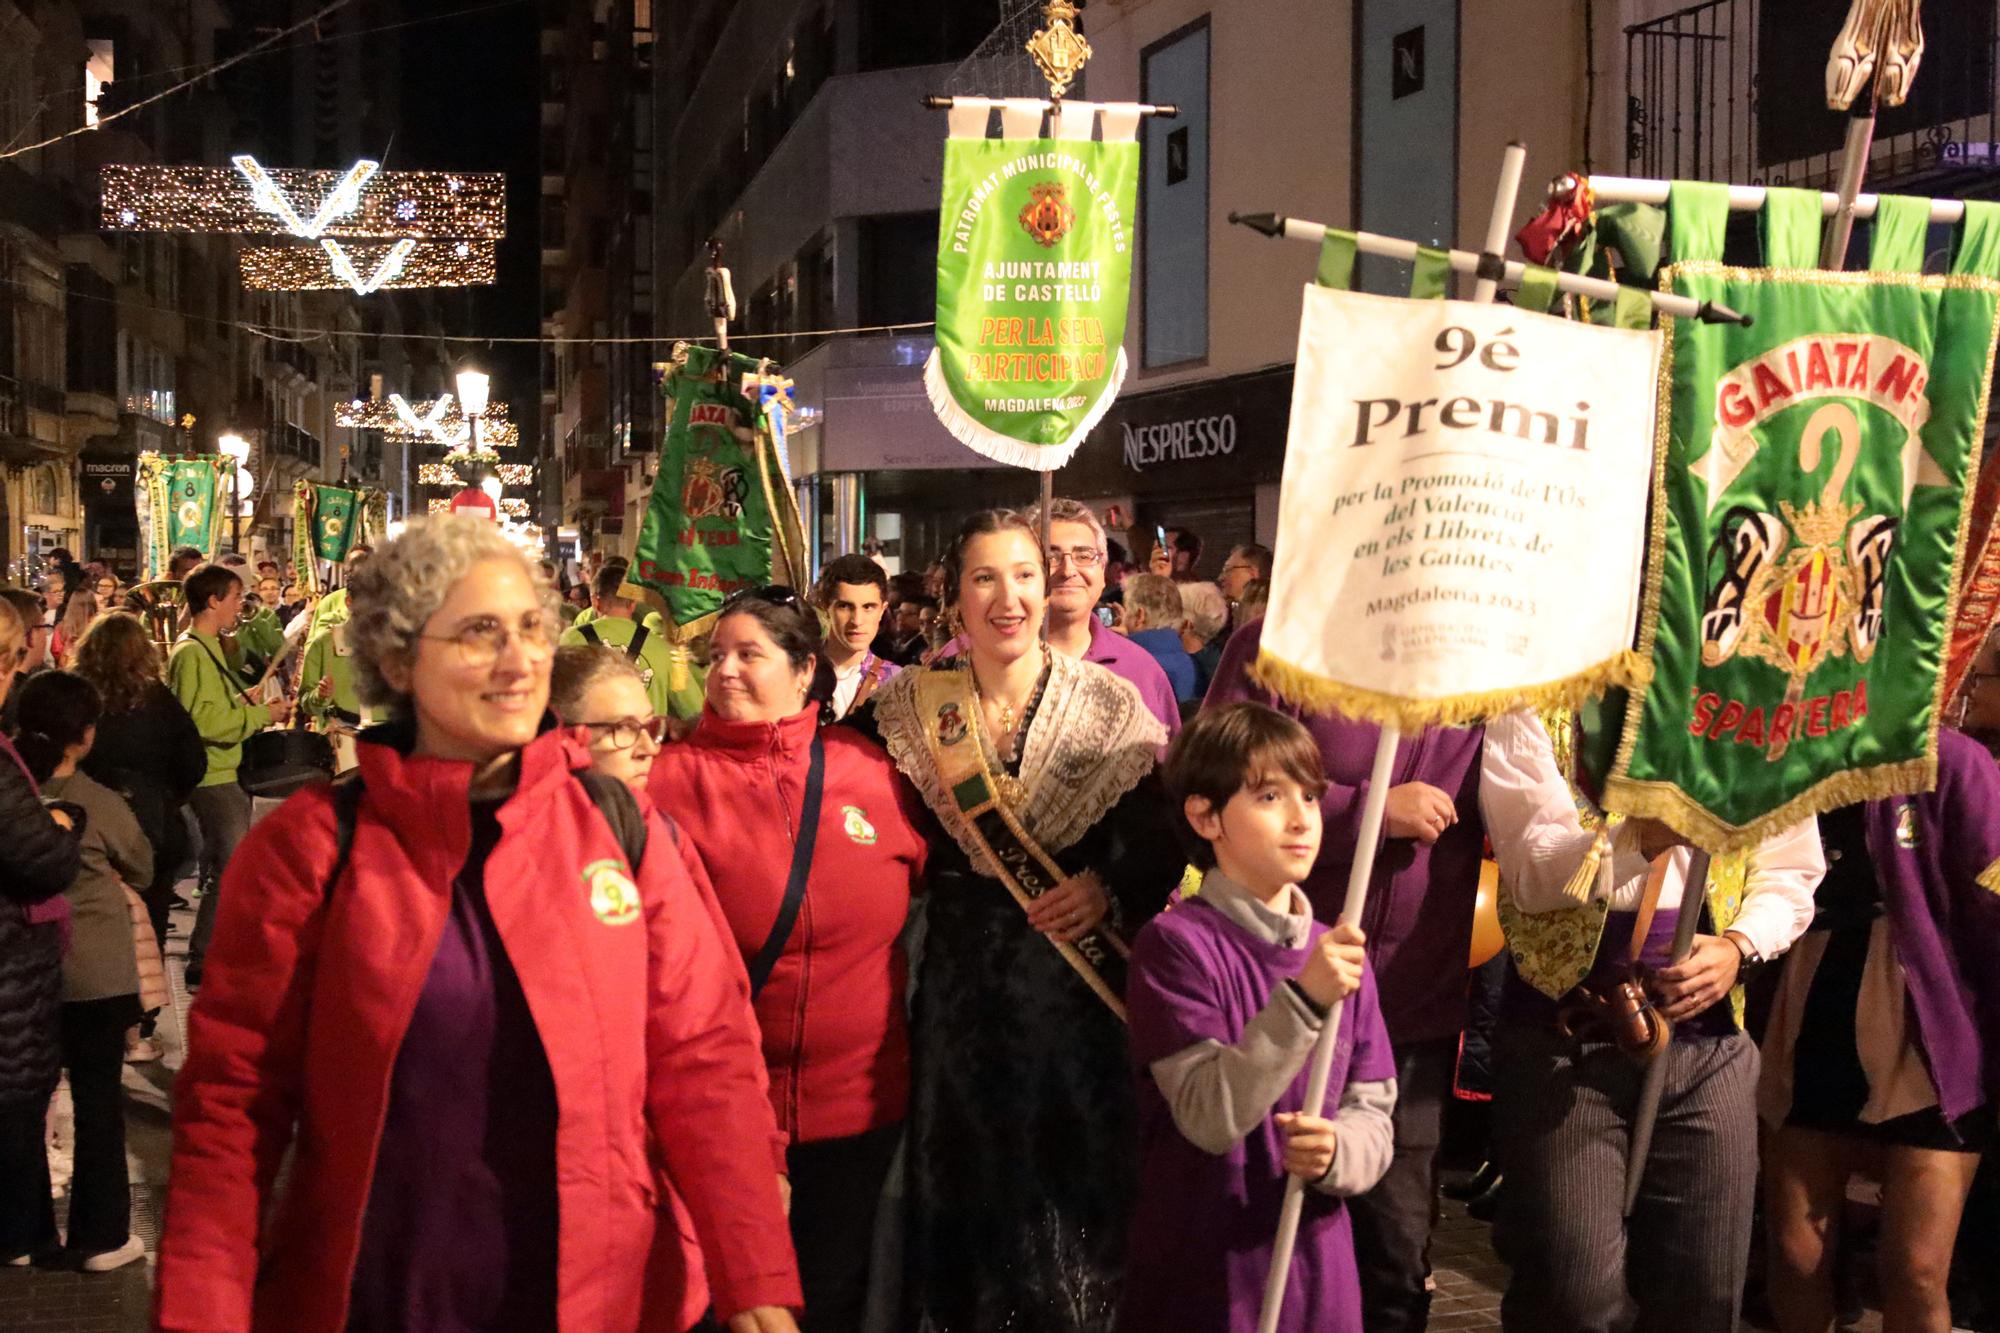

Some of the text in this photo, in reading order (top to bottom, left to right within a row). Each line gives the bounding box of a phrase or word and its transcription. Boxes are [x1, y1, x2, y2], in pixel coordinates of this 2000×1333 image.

[1396, 47, 1418, 79] N
[953, 152, 1126, 253] PATRONAT MUNICIPAL DE FESTES
[983, 261, 1100, 280] AJUNTAMENT
[983, 280, 1101, 302] DE CASTELLÓ
[979, 317, 1105, 346] PER LA SEUA
[1433, 325, 1520, 372] 9é
[1719, 342, 1871, 427] GAIATA
[985, 397, 1066, 413] MAGDALENA
[1348, 395, 1591, 451] Premi
[1120, 414, 1236, 473] NESPRESSO
[86, 463, 130, 473] macron
[185, 482, 196, 497] 8
[1332, 490, 1368, 515] per
[1373, 482, 1393, 501] la
[1400, 472, 1504, 496] Promoció
[1511, 479, 1536, 498] de
[1383, 497, 1417, 526] del
[1353, 520, 1554, 559] en els Llibrets de
[1382, 547, 1515, 577] les Gaiates
[1365, 585, 1537, 617] Magdalena 2023
